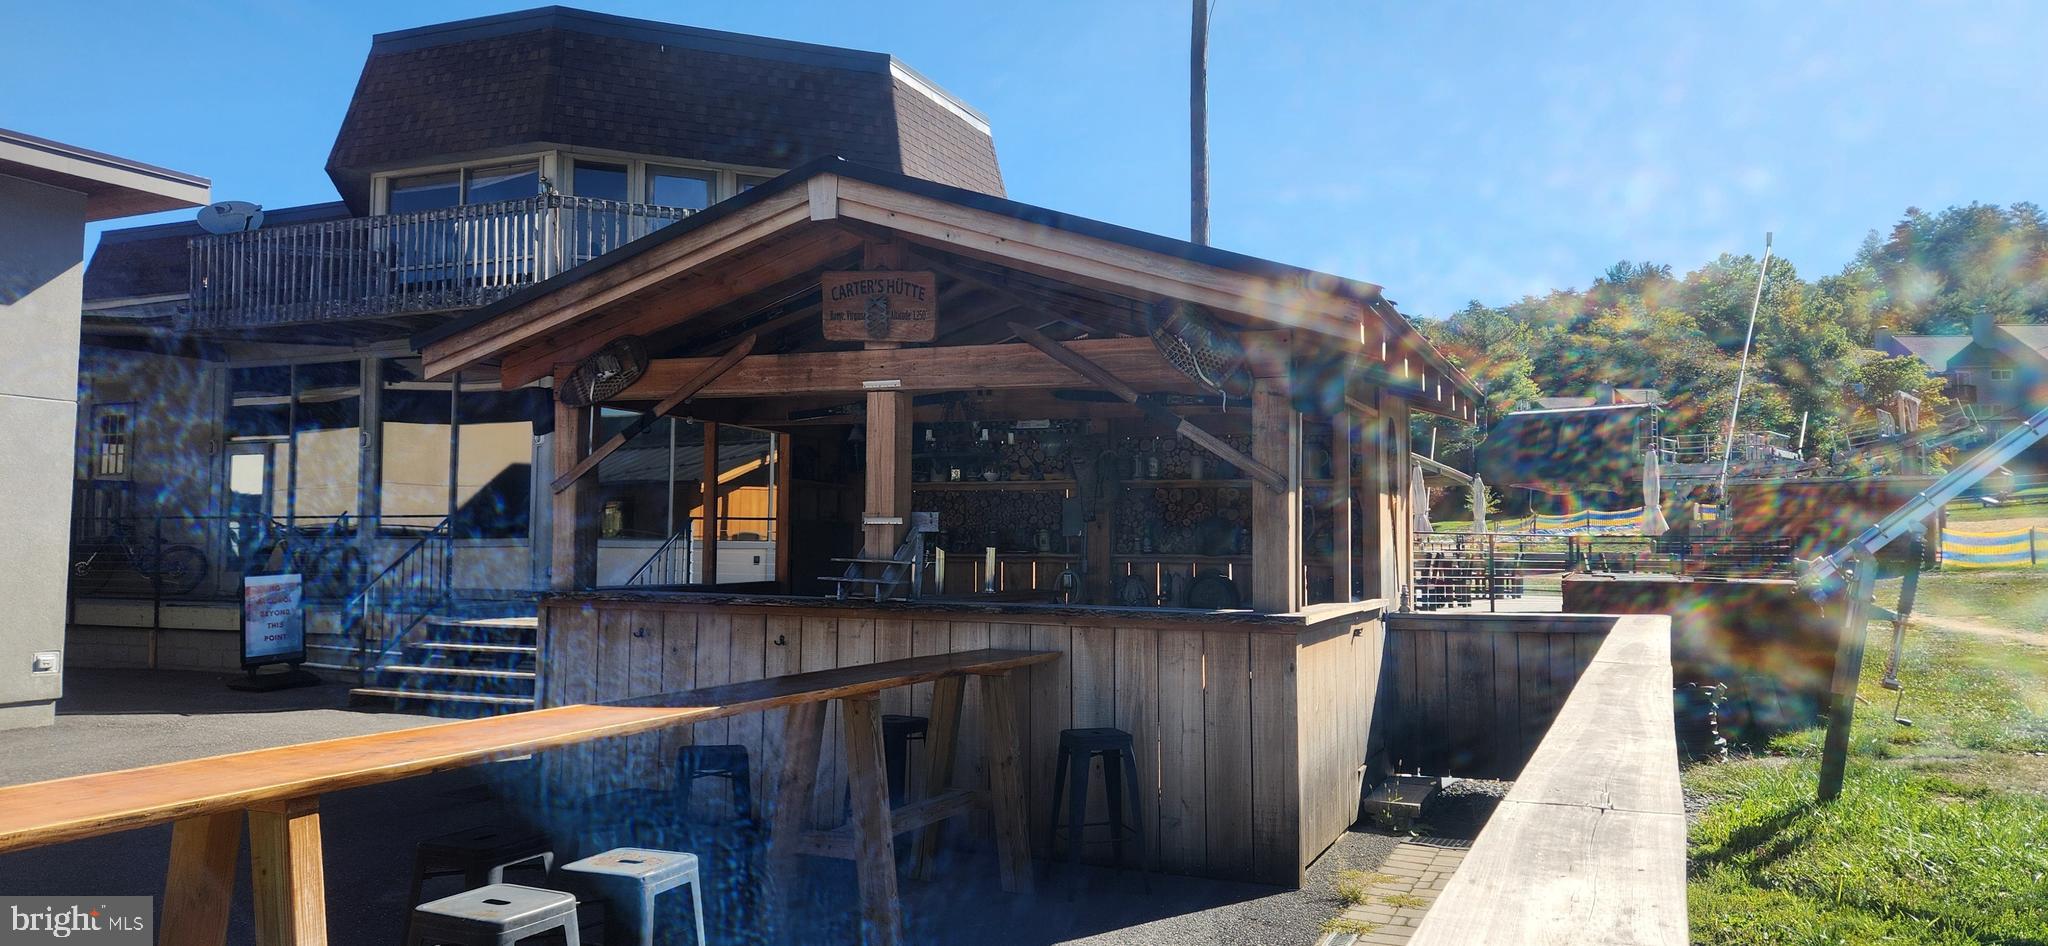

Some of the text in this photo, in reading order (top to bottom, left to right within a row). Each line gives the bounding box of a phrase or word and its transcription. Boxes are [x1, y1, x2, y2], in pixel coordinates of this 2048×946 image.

[831, 277, 926, 302] CARTER'S HÜTTE
[267, 622, 285, 630] THIS
[264, 633, 287, 642] POINT
